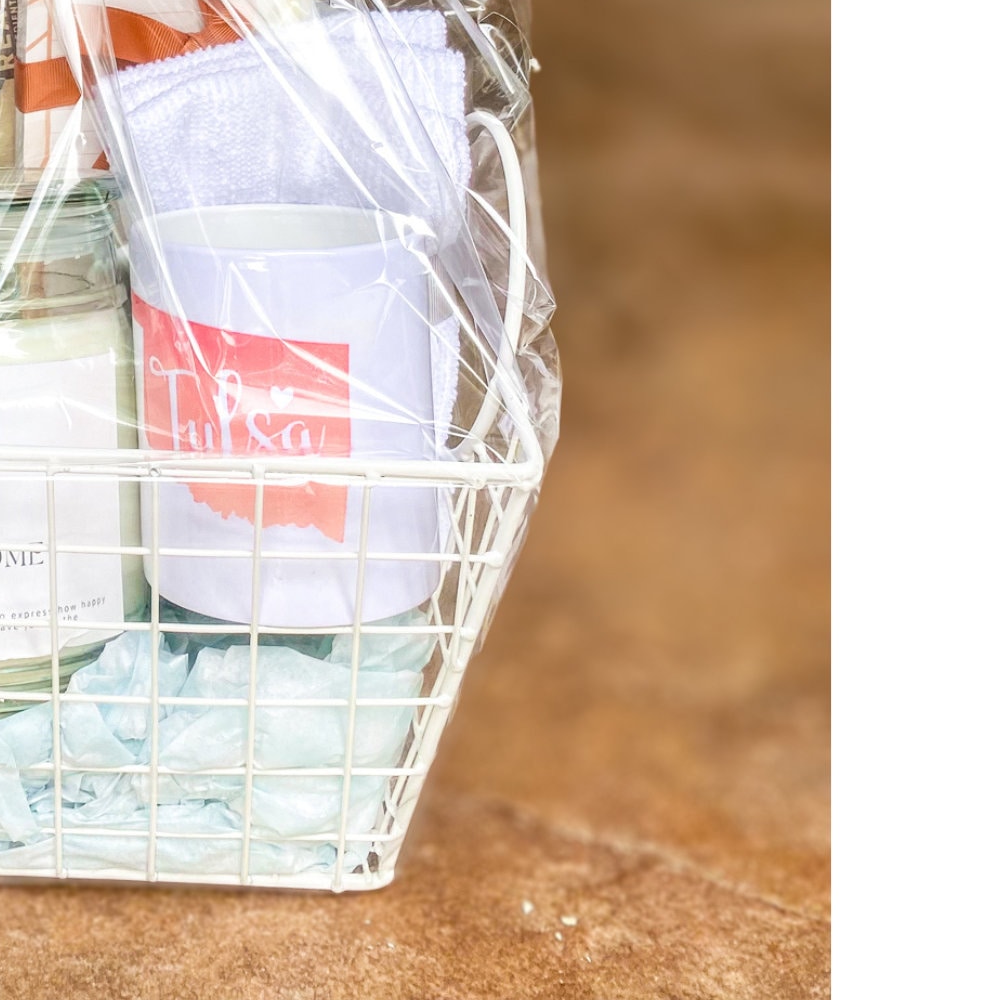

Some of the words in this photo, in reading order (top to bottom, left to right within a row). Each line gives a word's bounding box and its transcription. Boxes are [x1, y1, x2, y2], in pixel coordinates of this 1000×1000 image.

[149, 355, 326, 457] Tulsa
[11, 608, 52, 621] expres
[80, 595, 106, 609] happy
